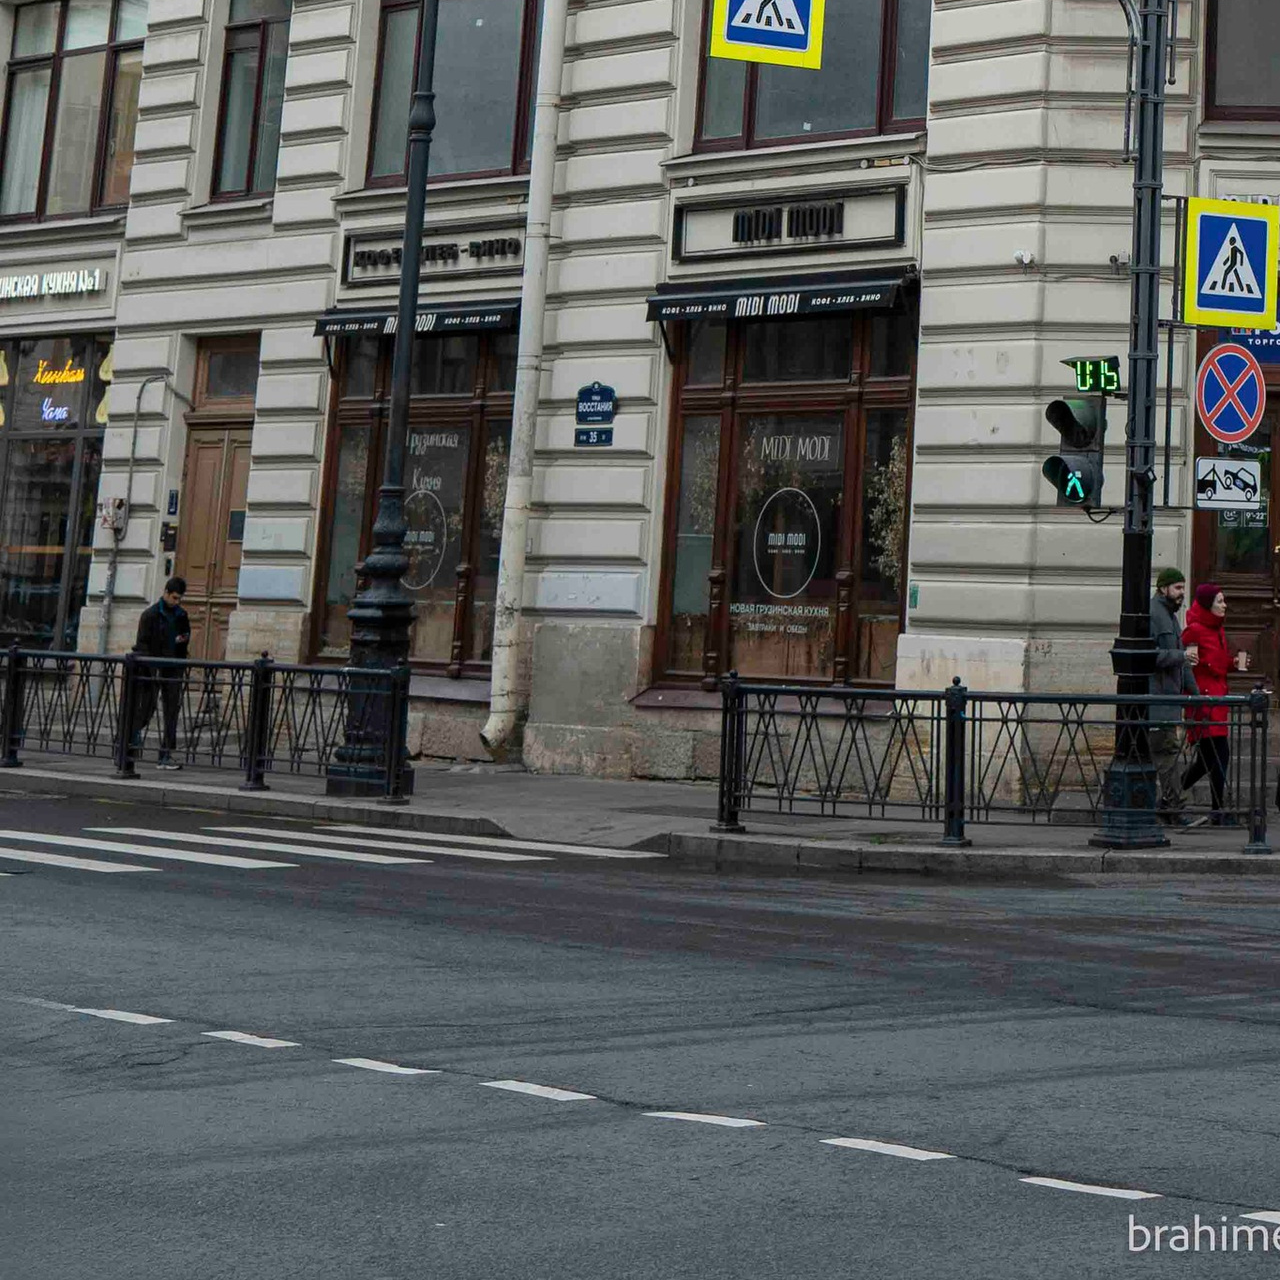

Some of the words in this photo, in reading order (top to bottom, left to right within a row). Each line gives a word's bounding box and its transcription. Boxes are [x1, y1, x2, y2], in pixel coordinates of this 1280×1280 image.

[733, 208, 782, 242] MIDI
[787, 202, 844, 238] MODI
[42, 271, 77, 294] КУХНЯ
[78, 268, 100, 291] №1
[735, 297, 763, 317] MIDI
[767, 293, 800, 315] MODI
[578, 401, 613, 412] ВОССТАНИЯ
[589, 431, 598, 442] 35
[760, 435, 793, 460] MIDI
[796, 435, 832, 461] MODI
[767, 533, 786, 546] MIDI
[786, 533, 806, 546] MODI
[729, 603, 755, 614] НОВАЯ
[756, 604, 803, 616] ГРУЗИНСКАЯ
[804, 606, 829, 617] КУХНЯ
[747, 622, 777, 632] ЗАВТРАКИ
